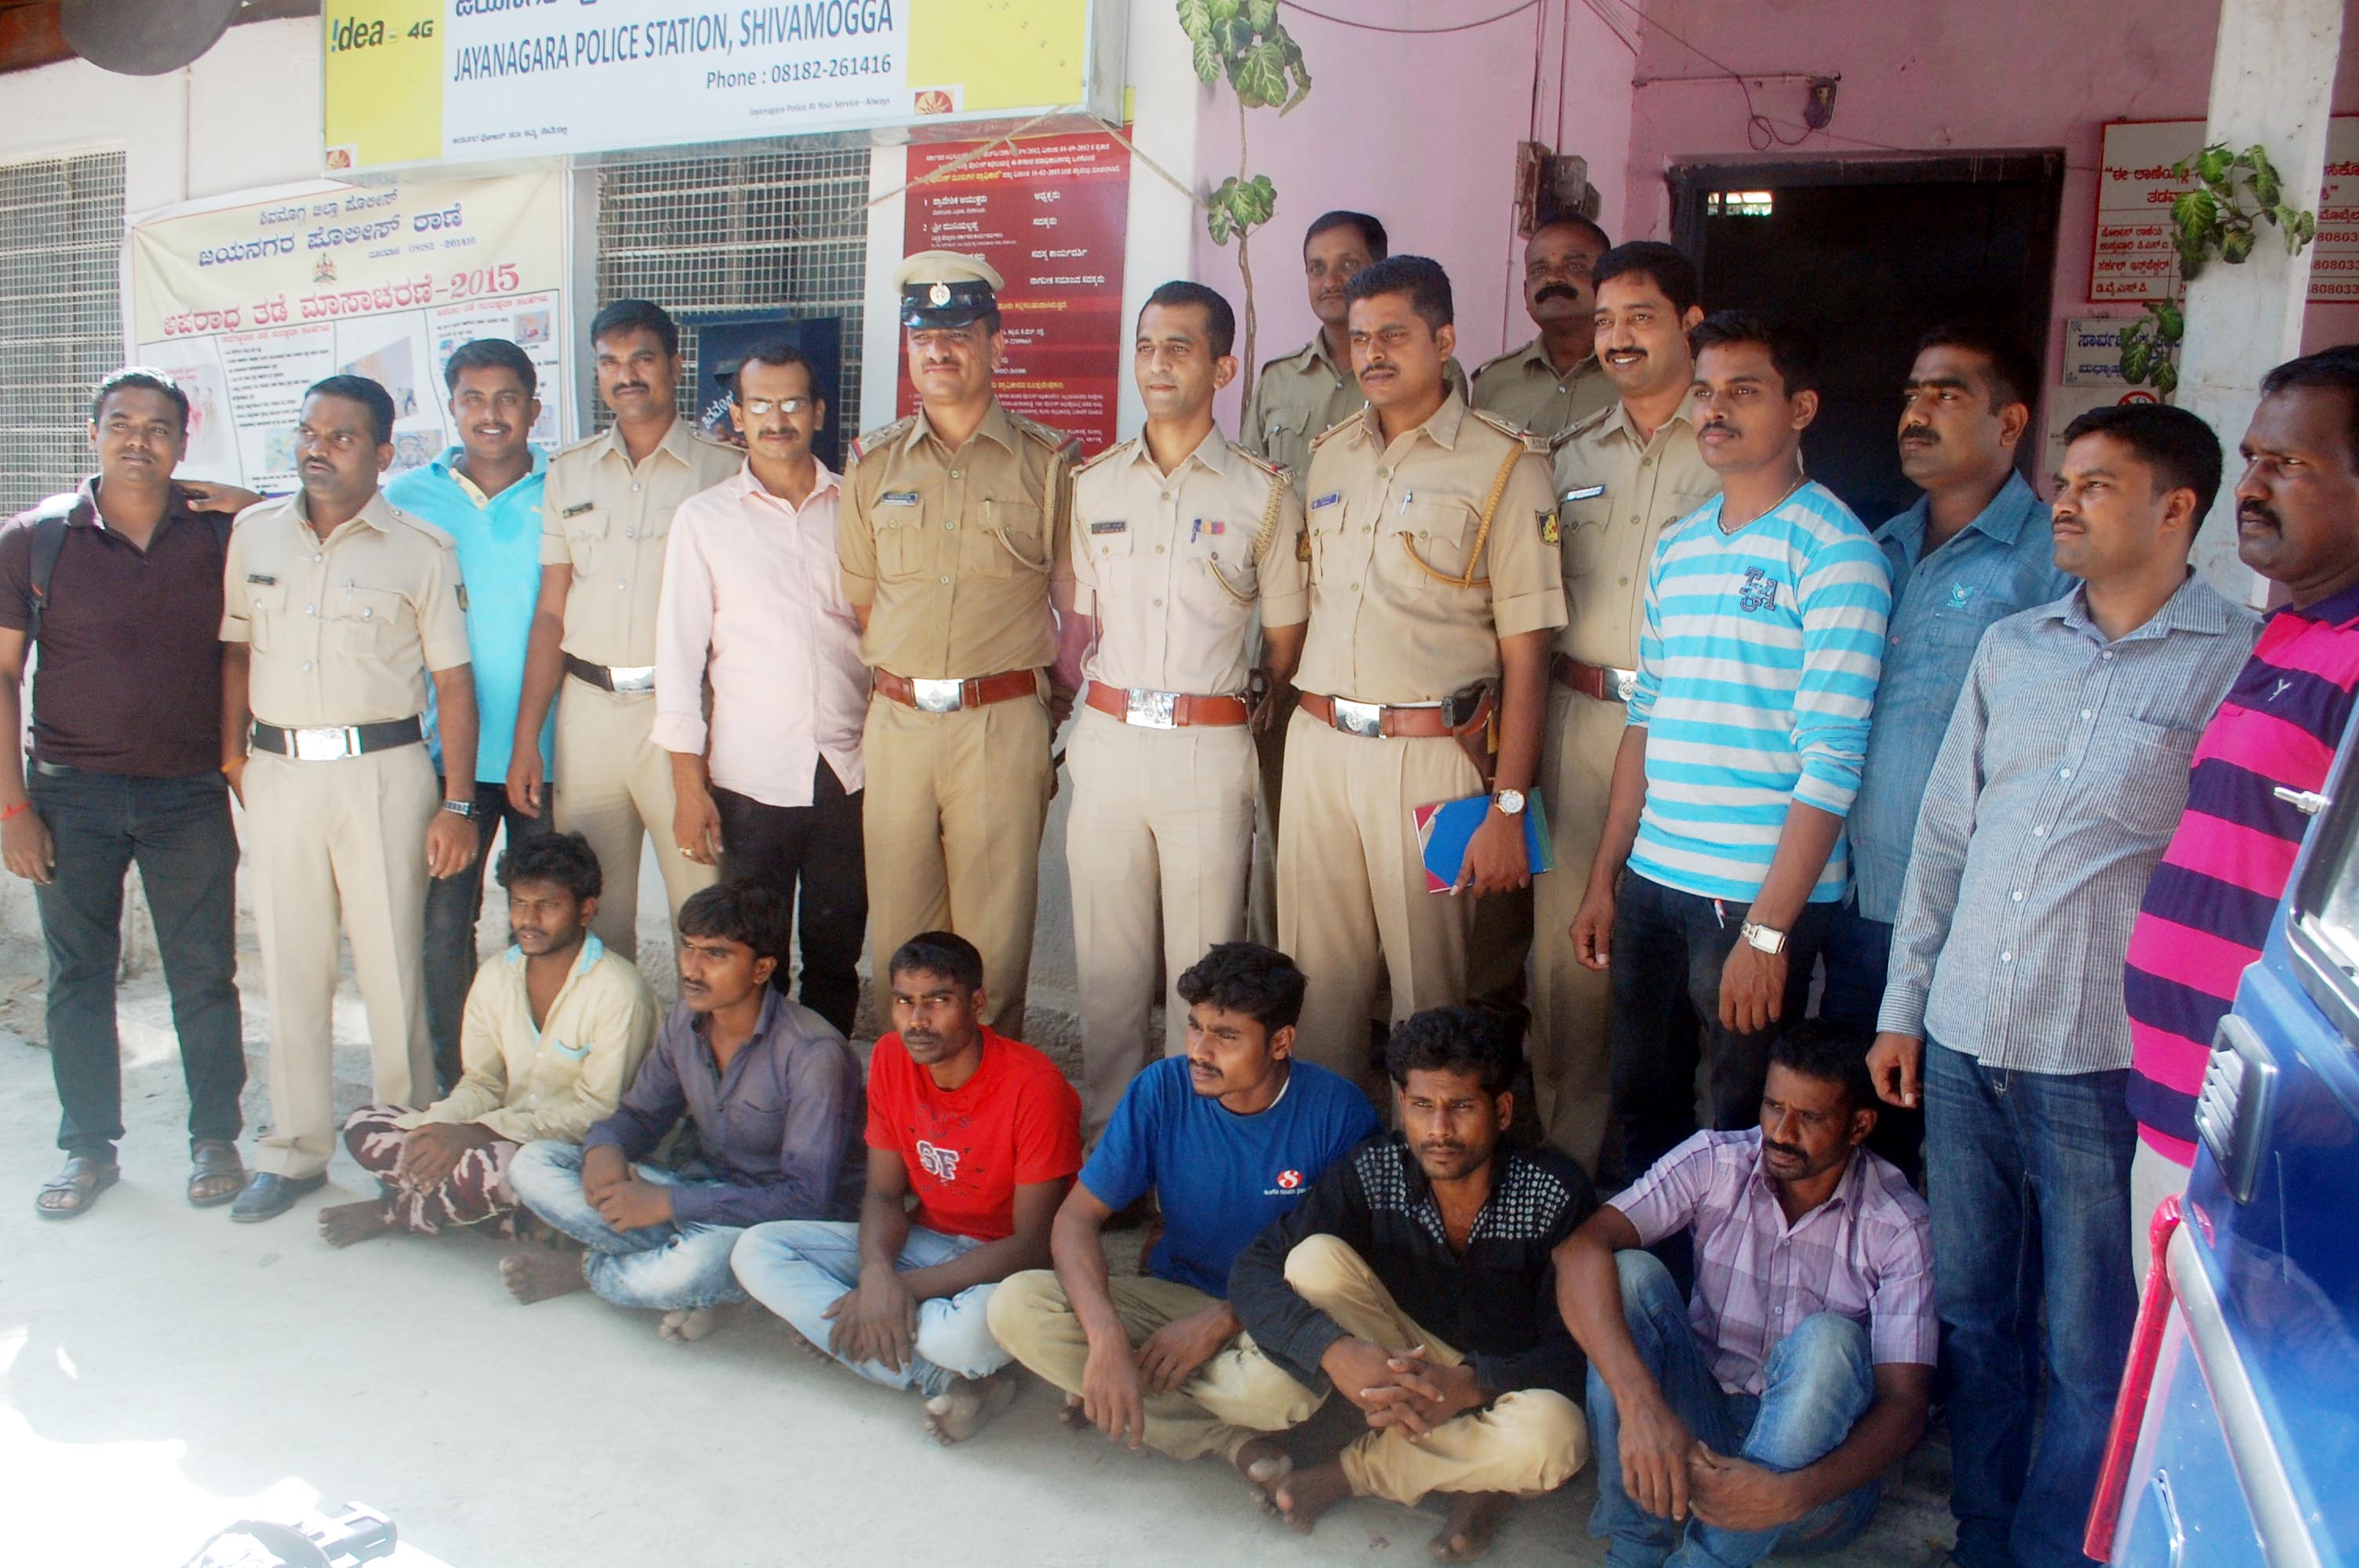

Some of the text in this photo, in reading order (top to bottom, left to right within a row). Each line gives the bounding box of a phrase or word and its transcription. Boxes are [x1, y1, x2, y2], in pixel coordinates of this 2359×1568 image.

[407, 20, 434, 39] 4G
[454, 0, 892, 82] JAYANAGARA POLICE STATION, SHIVAMOGGA
[707, 70, 756, 89] Phone
[771, 53, 891, 84] 08182-261416
[787, 103, 807, 112] Police
[818, 100, 833, 110] Your
[835, 98, 859, 108] Service
[865, 96, 890, 107] Always
[198, 231, 296, 267] ಜಯನಗರ
[307, 214, 401, 249] ಪೊಲೀಸ್
[163, 301, 241, 336] ಅಪರಾಧ
[253, 292, 288, 325] ತಡೆ
